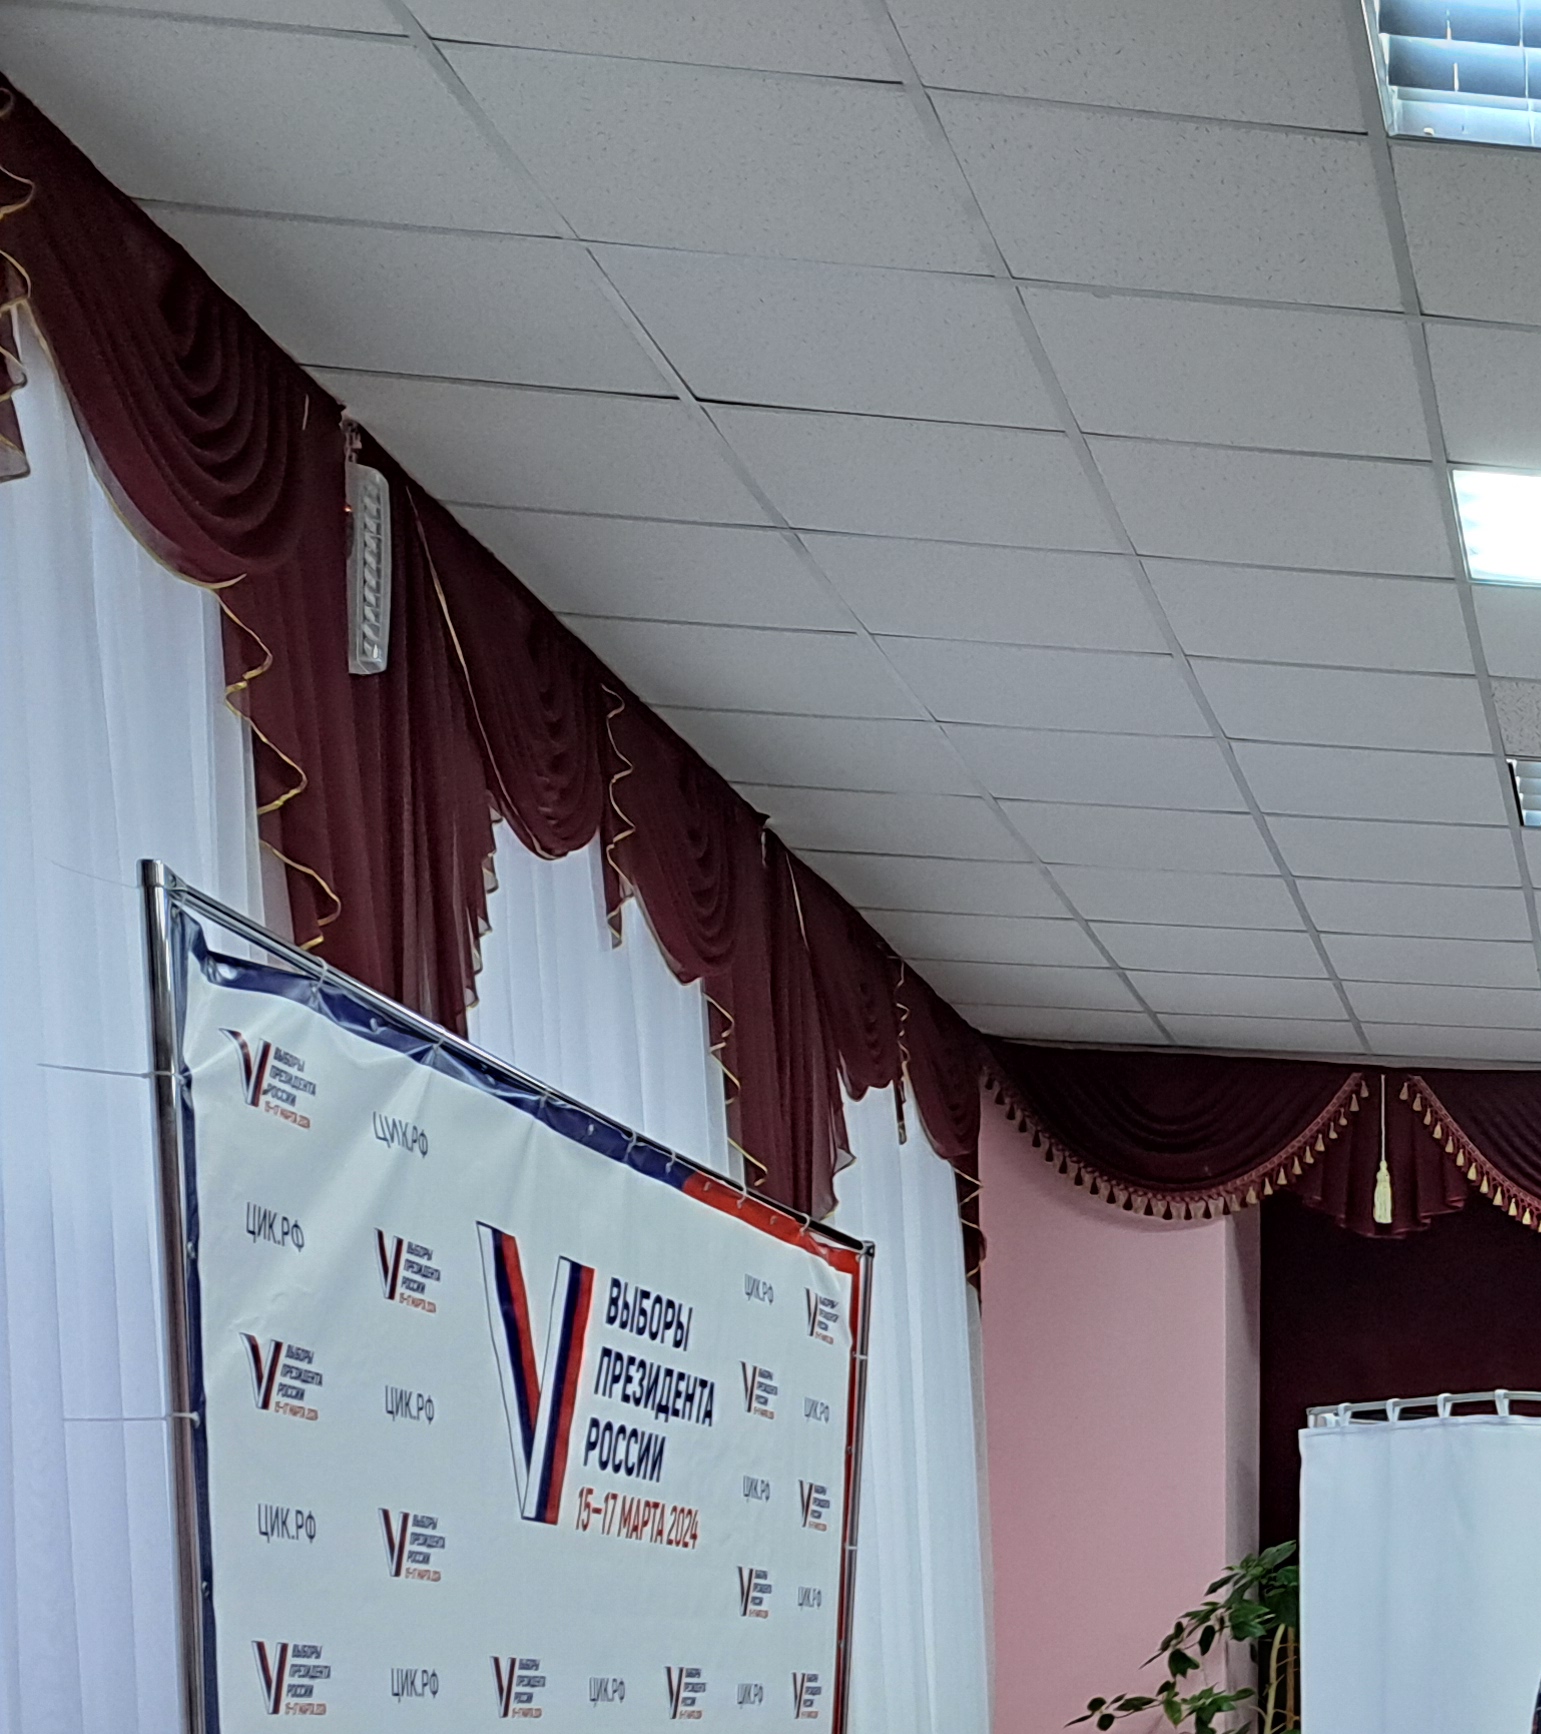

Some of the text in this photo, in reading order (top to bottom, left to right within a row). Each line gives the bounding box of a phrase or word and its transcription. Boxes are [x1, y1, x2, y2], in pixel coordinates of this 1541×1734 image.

[372, 1111, 429, 1159] ЦИК.РФ
[245, 1201, 305, 1253] ЦИК.РФ
[606, 1276, 693, 1352] ВЫБОРЫ
[384, 1384, 435, 1425] ЦИК.РФ
[594, 1346, 715, 1428] ПРЕЗИДЕНТА
[583, 1416, 666, 1483] РОССИИ
[257, 1503, 317, 1544] ЦИК.РФ
[617, 1495, 667, 1540] МАРТА
[665, 1506, 699, 1550] 2024
[390, 1667, 440, 1704] ЦИК.РФ
